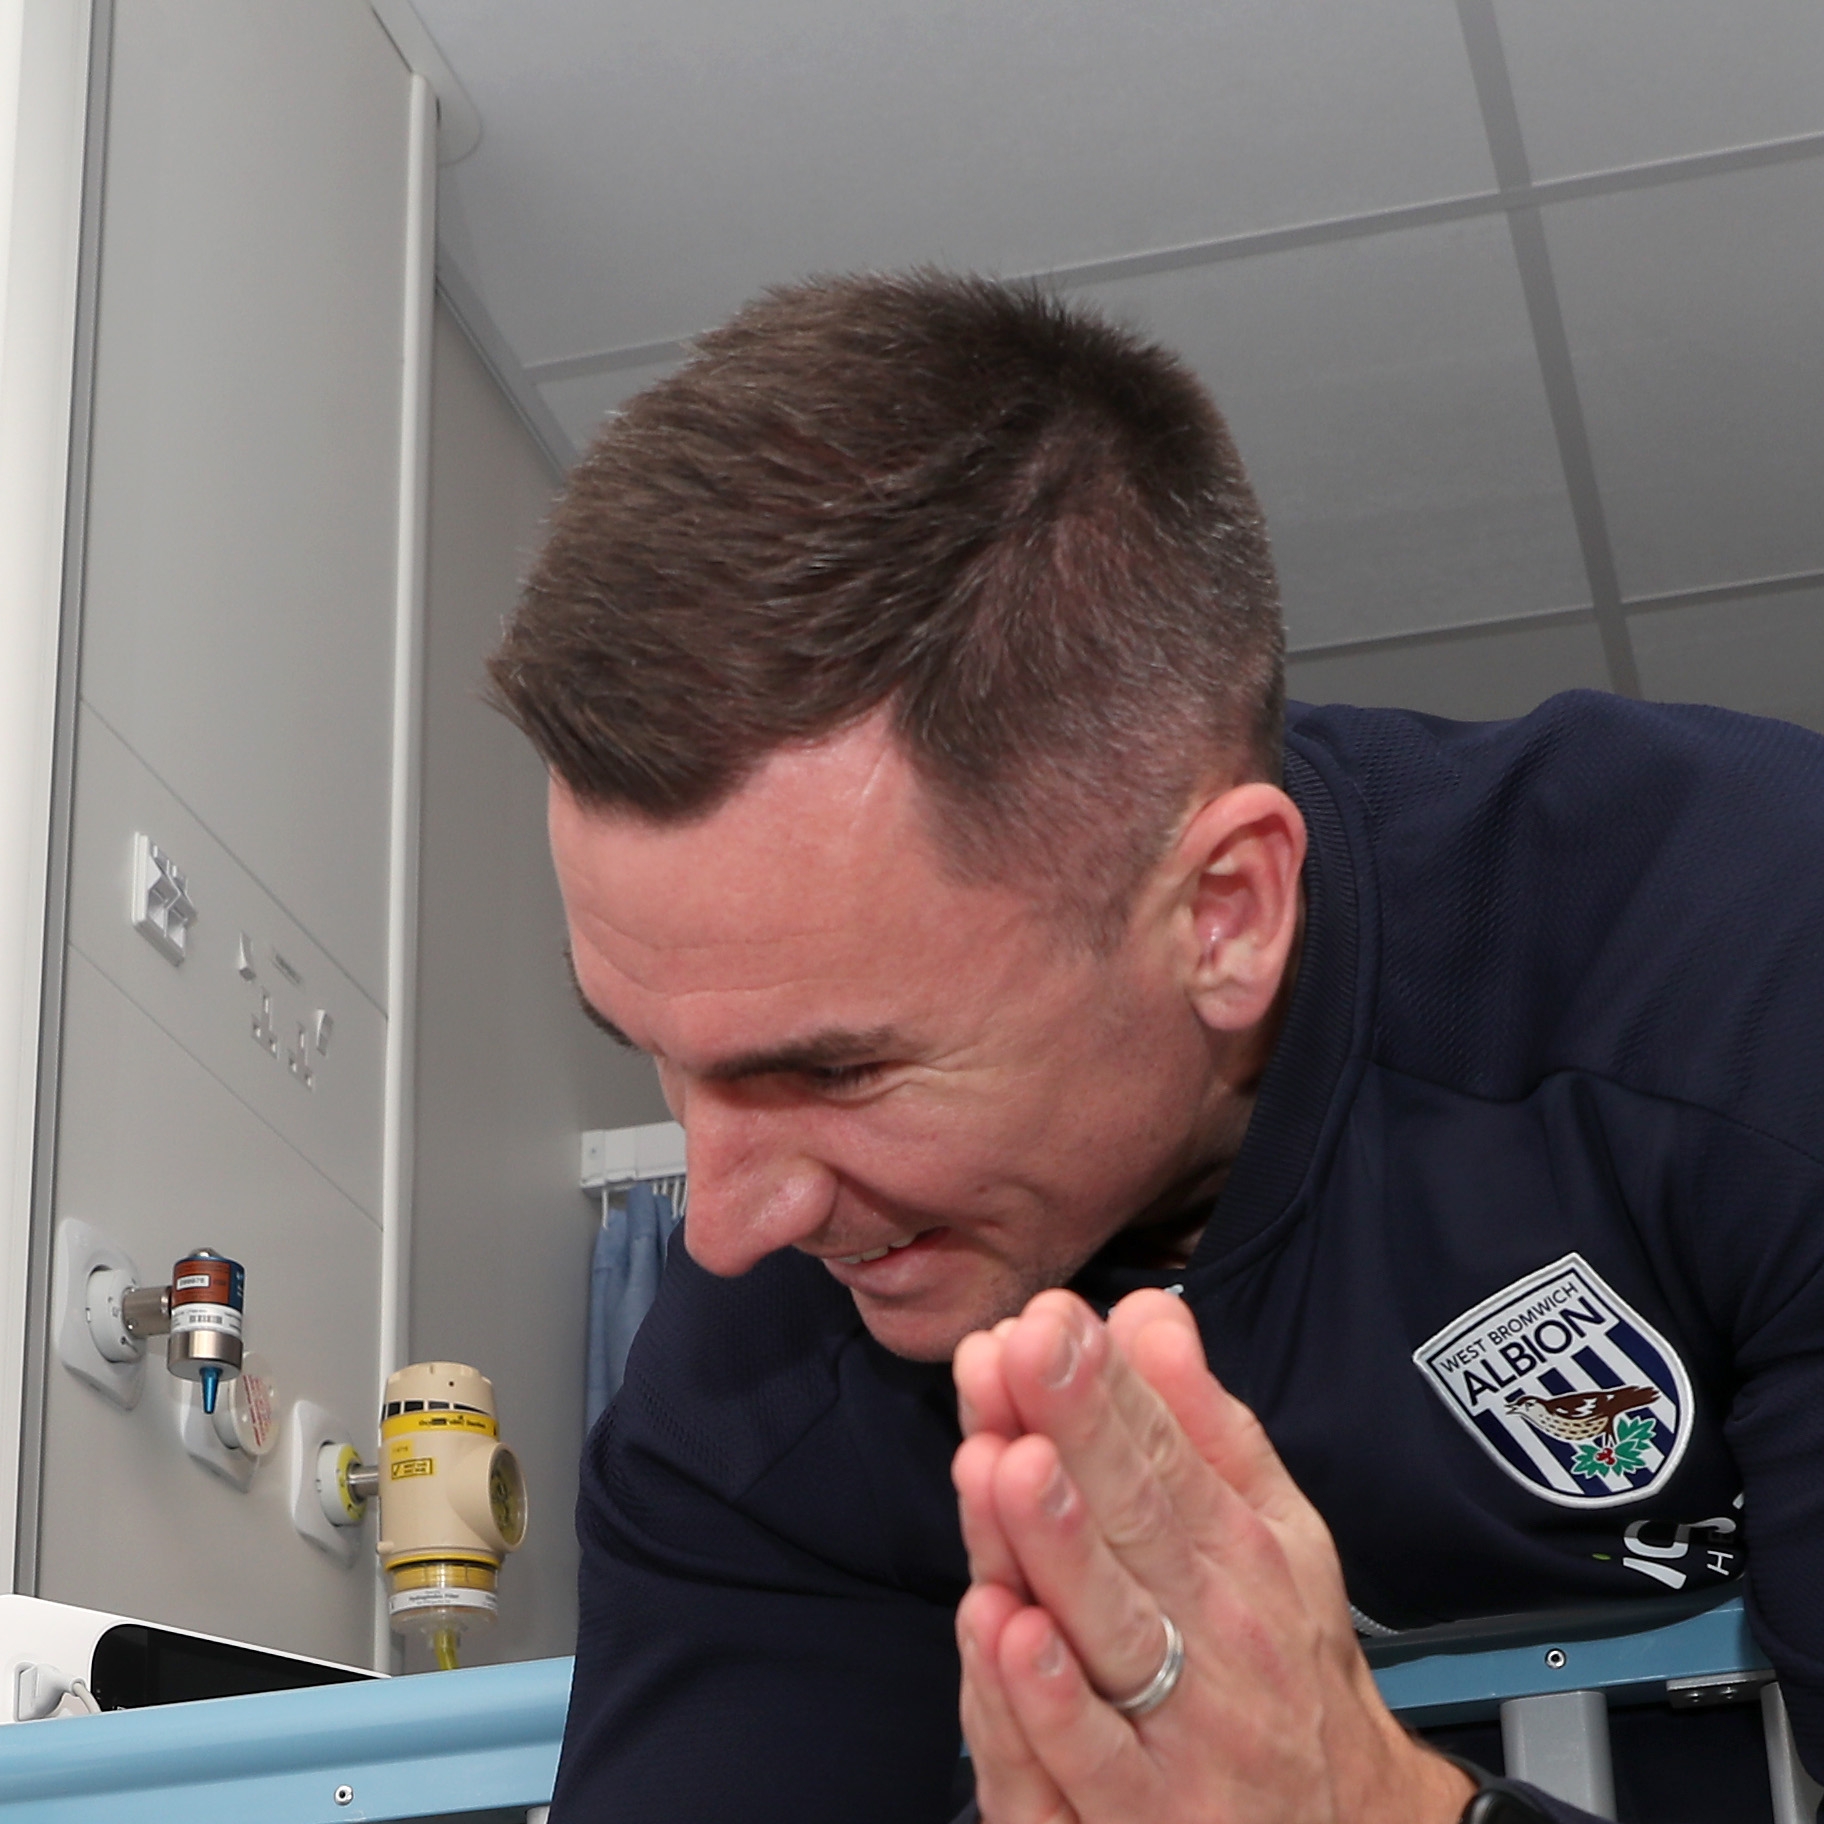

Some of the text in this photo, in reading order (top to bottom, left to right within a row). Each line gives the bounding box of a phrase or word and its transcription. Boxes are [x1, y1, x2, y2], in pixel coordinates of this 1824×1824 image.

[1440, 1282, 1578, 1373] WEST BROMWICH
[1463, 1296, 1606, 1407] ALBION
